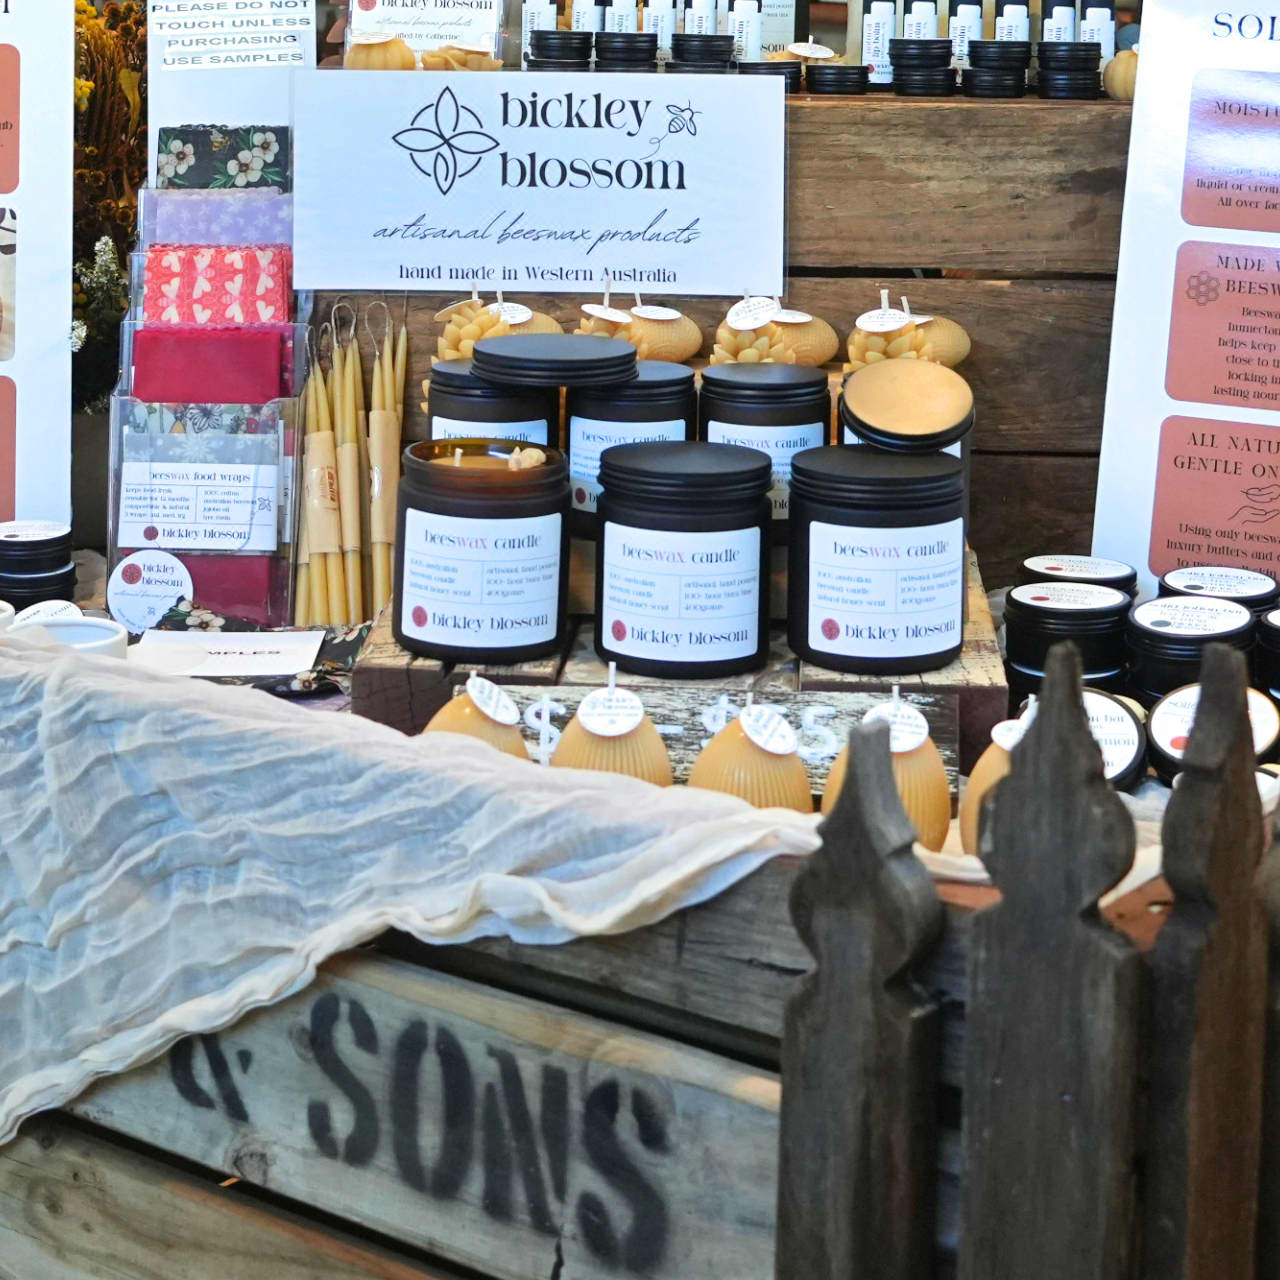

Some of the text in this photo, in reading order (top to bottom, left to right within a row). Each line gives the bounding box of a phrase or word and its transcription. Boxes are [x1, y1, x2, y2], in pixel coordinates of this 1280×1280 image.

[152, 0, 310, 12] PLEASE DO NOT
[156, 18, 311, 30] TOUCH UNLESS
[168, 36, 297, 47] PURCHASING
[163, 53, 303, 65] USE SAMPLES
[500, 92, 652, 136] bickley
[500, 152, 687, 190] blossom
[1218, 197, 1231, 207] All
[1236, 199, 1261, 209] over
[373, 209, 701, 255] artisanal beeswax products
[1217, 256, 1265, 272] MADE
[399, 264, 676, 283] hand made in Western Australia
[722, 435, 811, 449] beeswax candle
[1187, 432, 1218, 449] ALL
[1173, 455, 1243, 476] GENTLE
[1252, 464, 1280, 479] ON
[194, 472, 216, 480] food
[220, 474, 250, 483] wraps
[162, 528, 200, 540] bickley
[424, 529, 542, 549] beeswax candle
[622, 544, 740, 563] beeswax candle
[834, 541, 950, 558] beeswax candle
[143, 563, 174, 575] bickley
[142, 577, 183, 587] blossom
[432, 612, 548, 632] bickley blossom
[631, 626, 749, 647] bickley blossom
[845, 620, 956, 648] bickley blossom
[307, 992, 670, 1274] SONS
